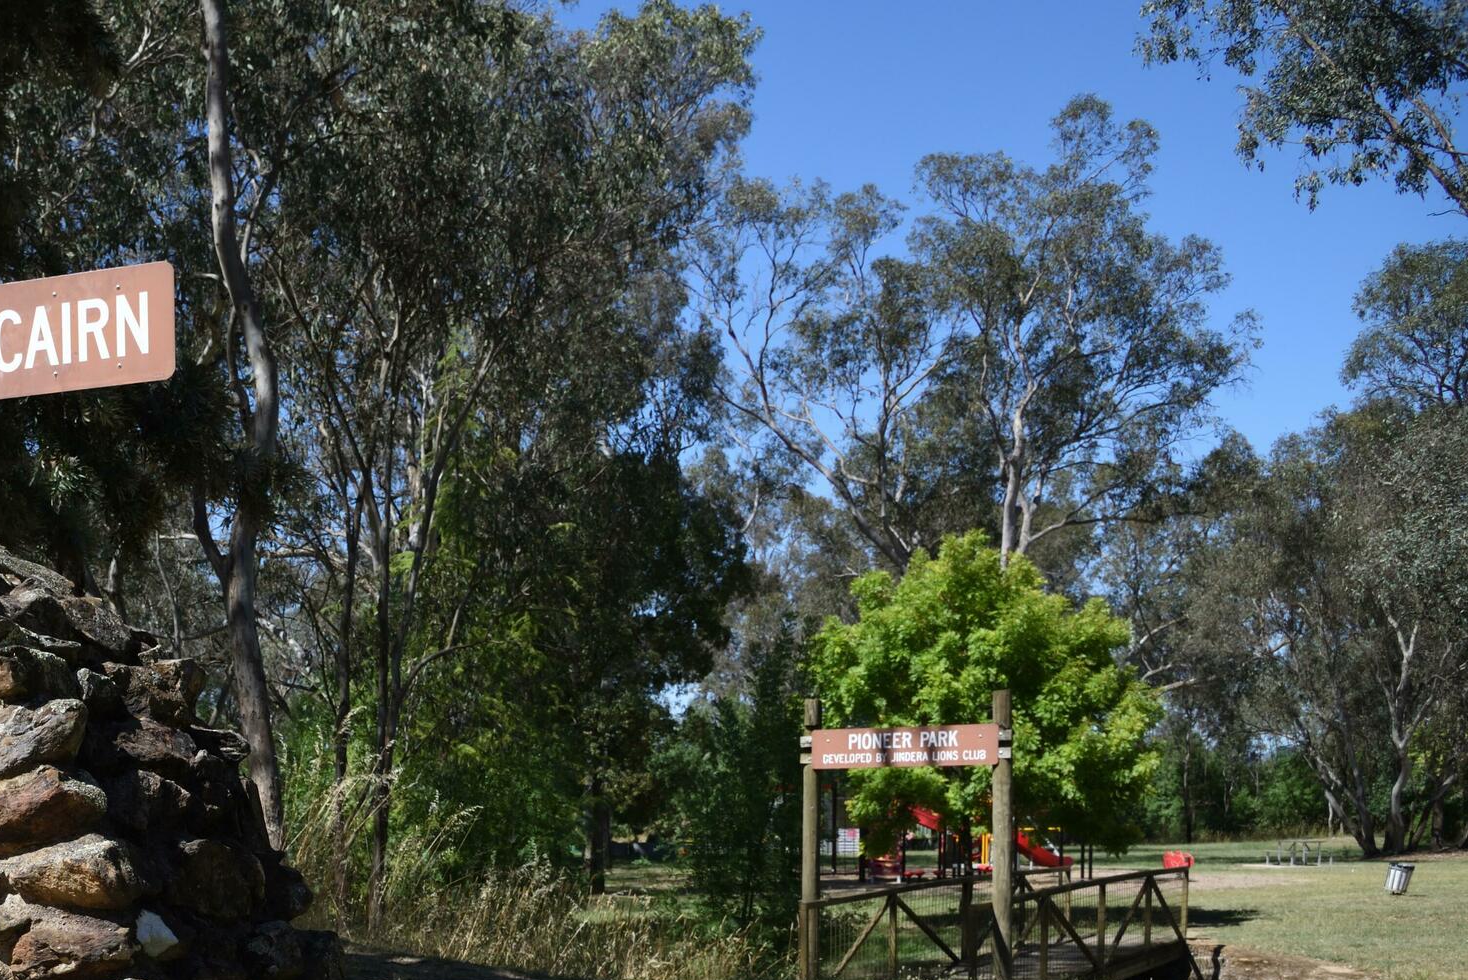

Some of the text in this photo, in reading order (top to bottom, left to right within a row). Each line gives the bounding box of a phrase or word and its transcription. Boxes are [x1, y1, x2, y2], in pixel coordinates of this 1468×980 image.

[848, 730, 958, 750] PIONEER PARK
[823, 748, 987, 764] DEVELOPED BY JINDERA LIONS CLUB
